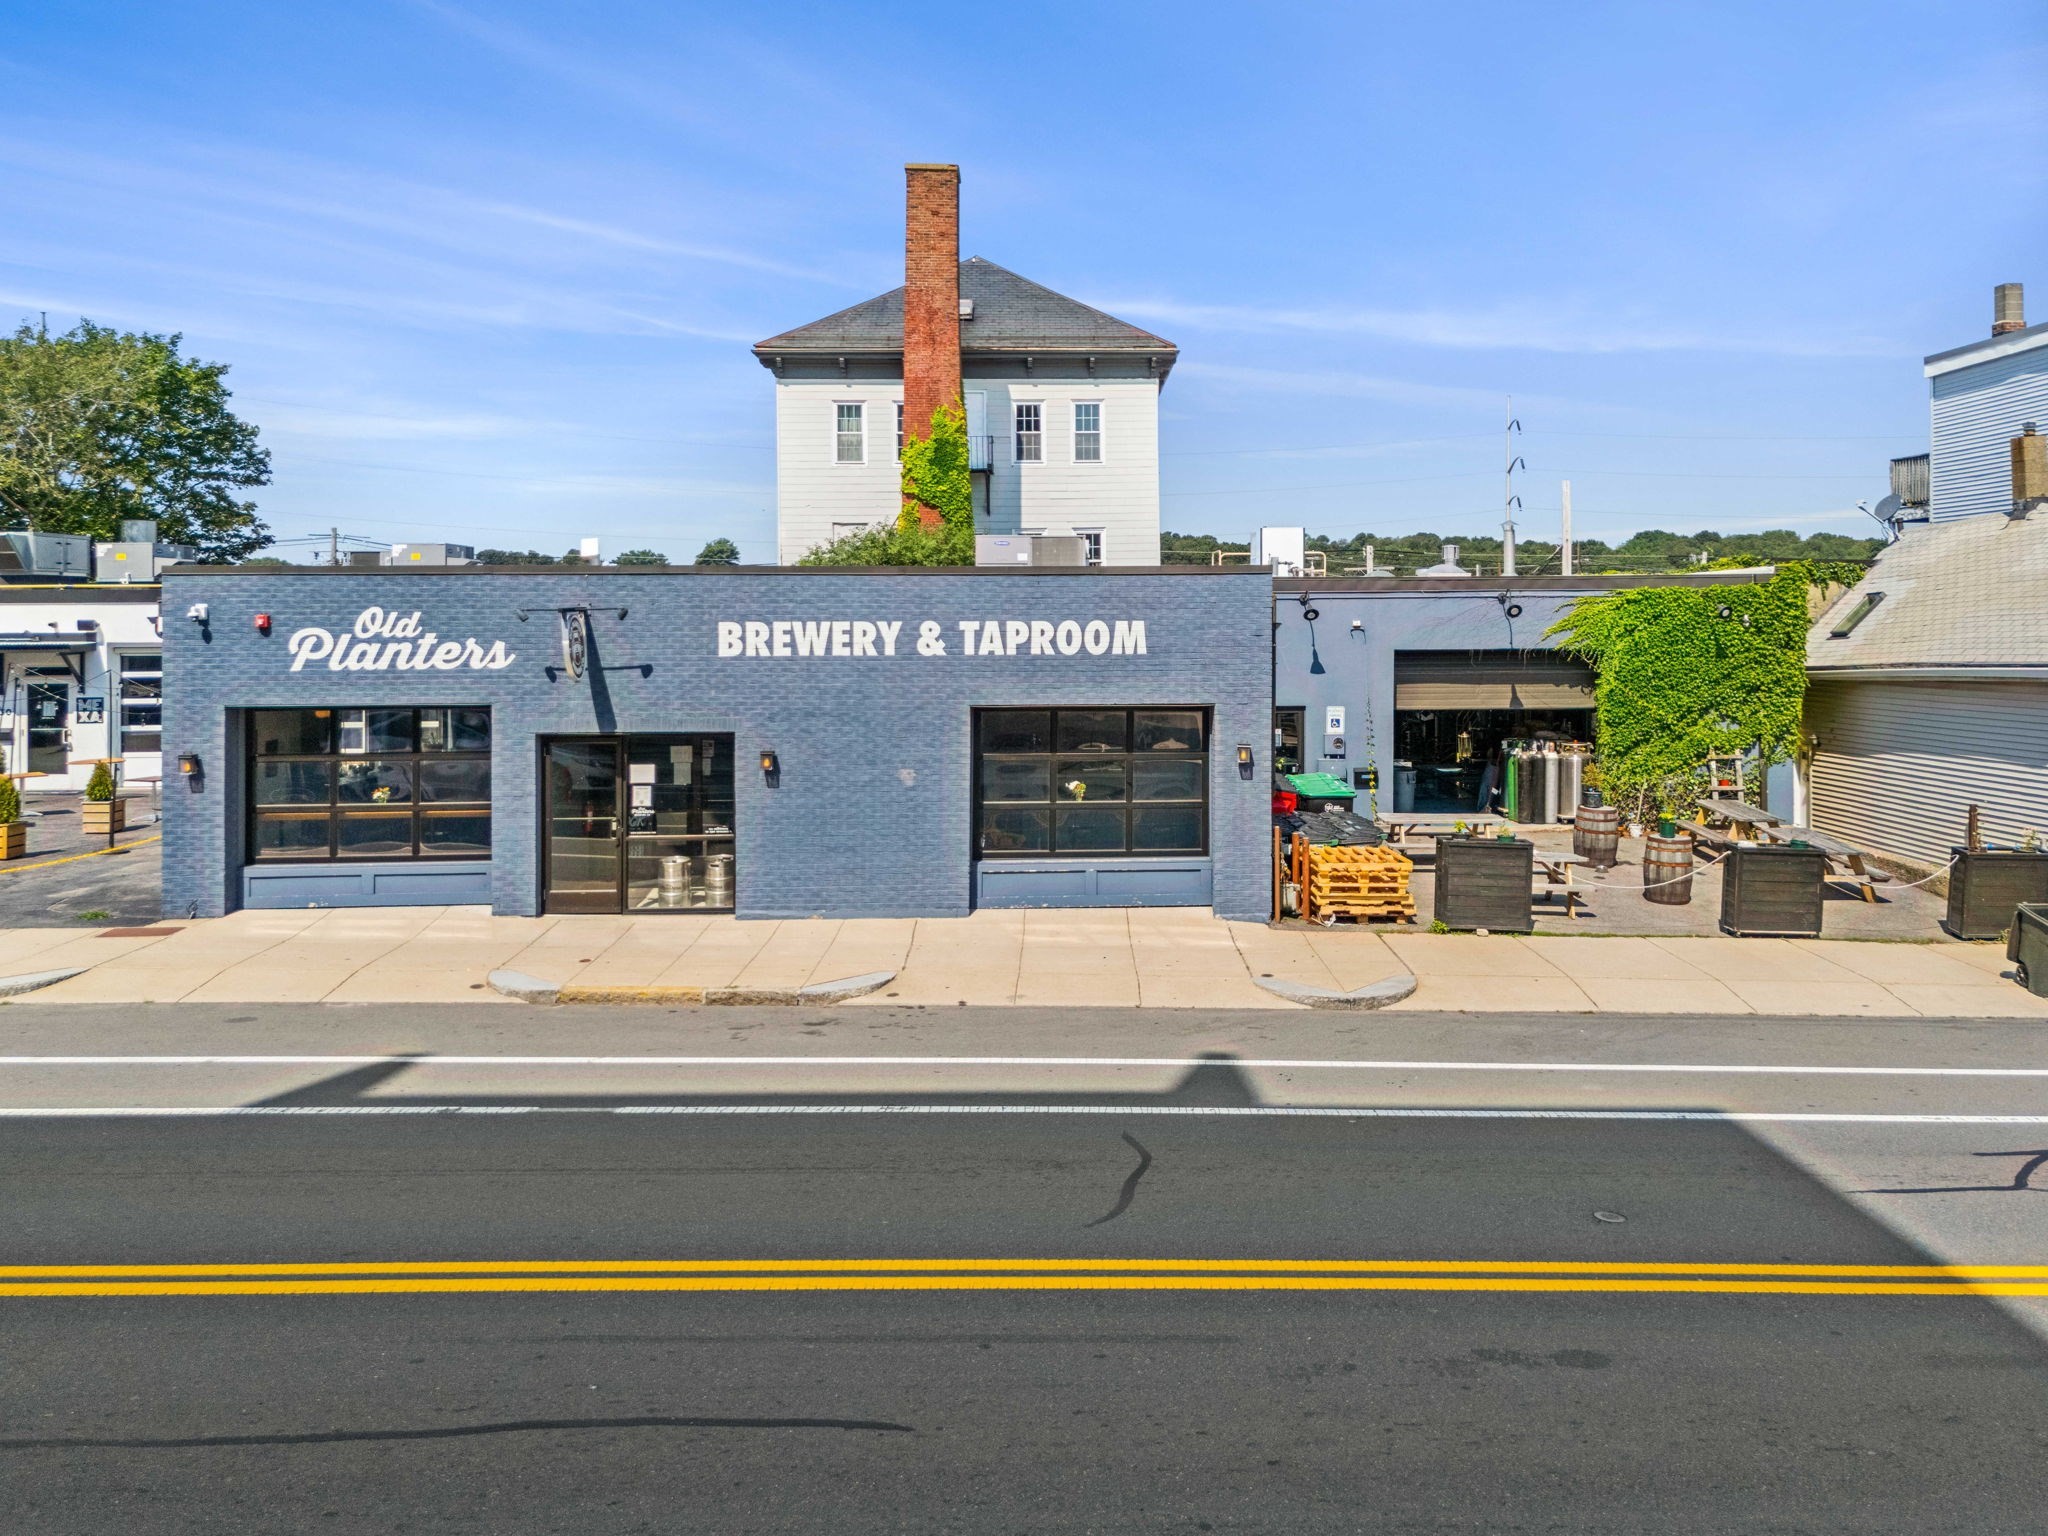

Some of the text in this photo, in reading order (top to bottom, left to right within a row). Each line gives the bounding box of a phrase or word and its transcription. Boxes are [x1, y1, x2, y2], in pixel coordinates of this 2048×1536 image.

[354, 606, 423, 639] Old
[717, 619, 1148, 658] BREWERY & TAPROOM
[287, 627, 517, 672] Planters
